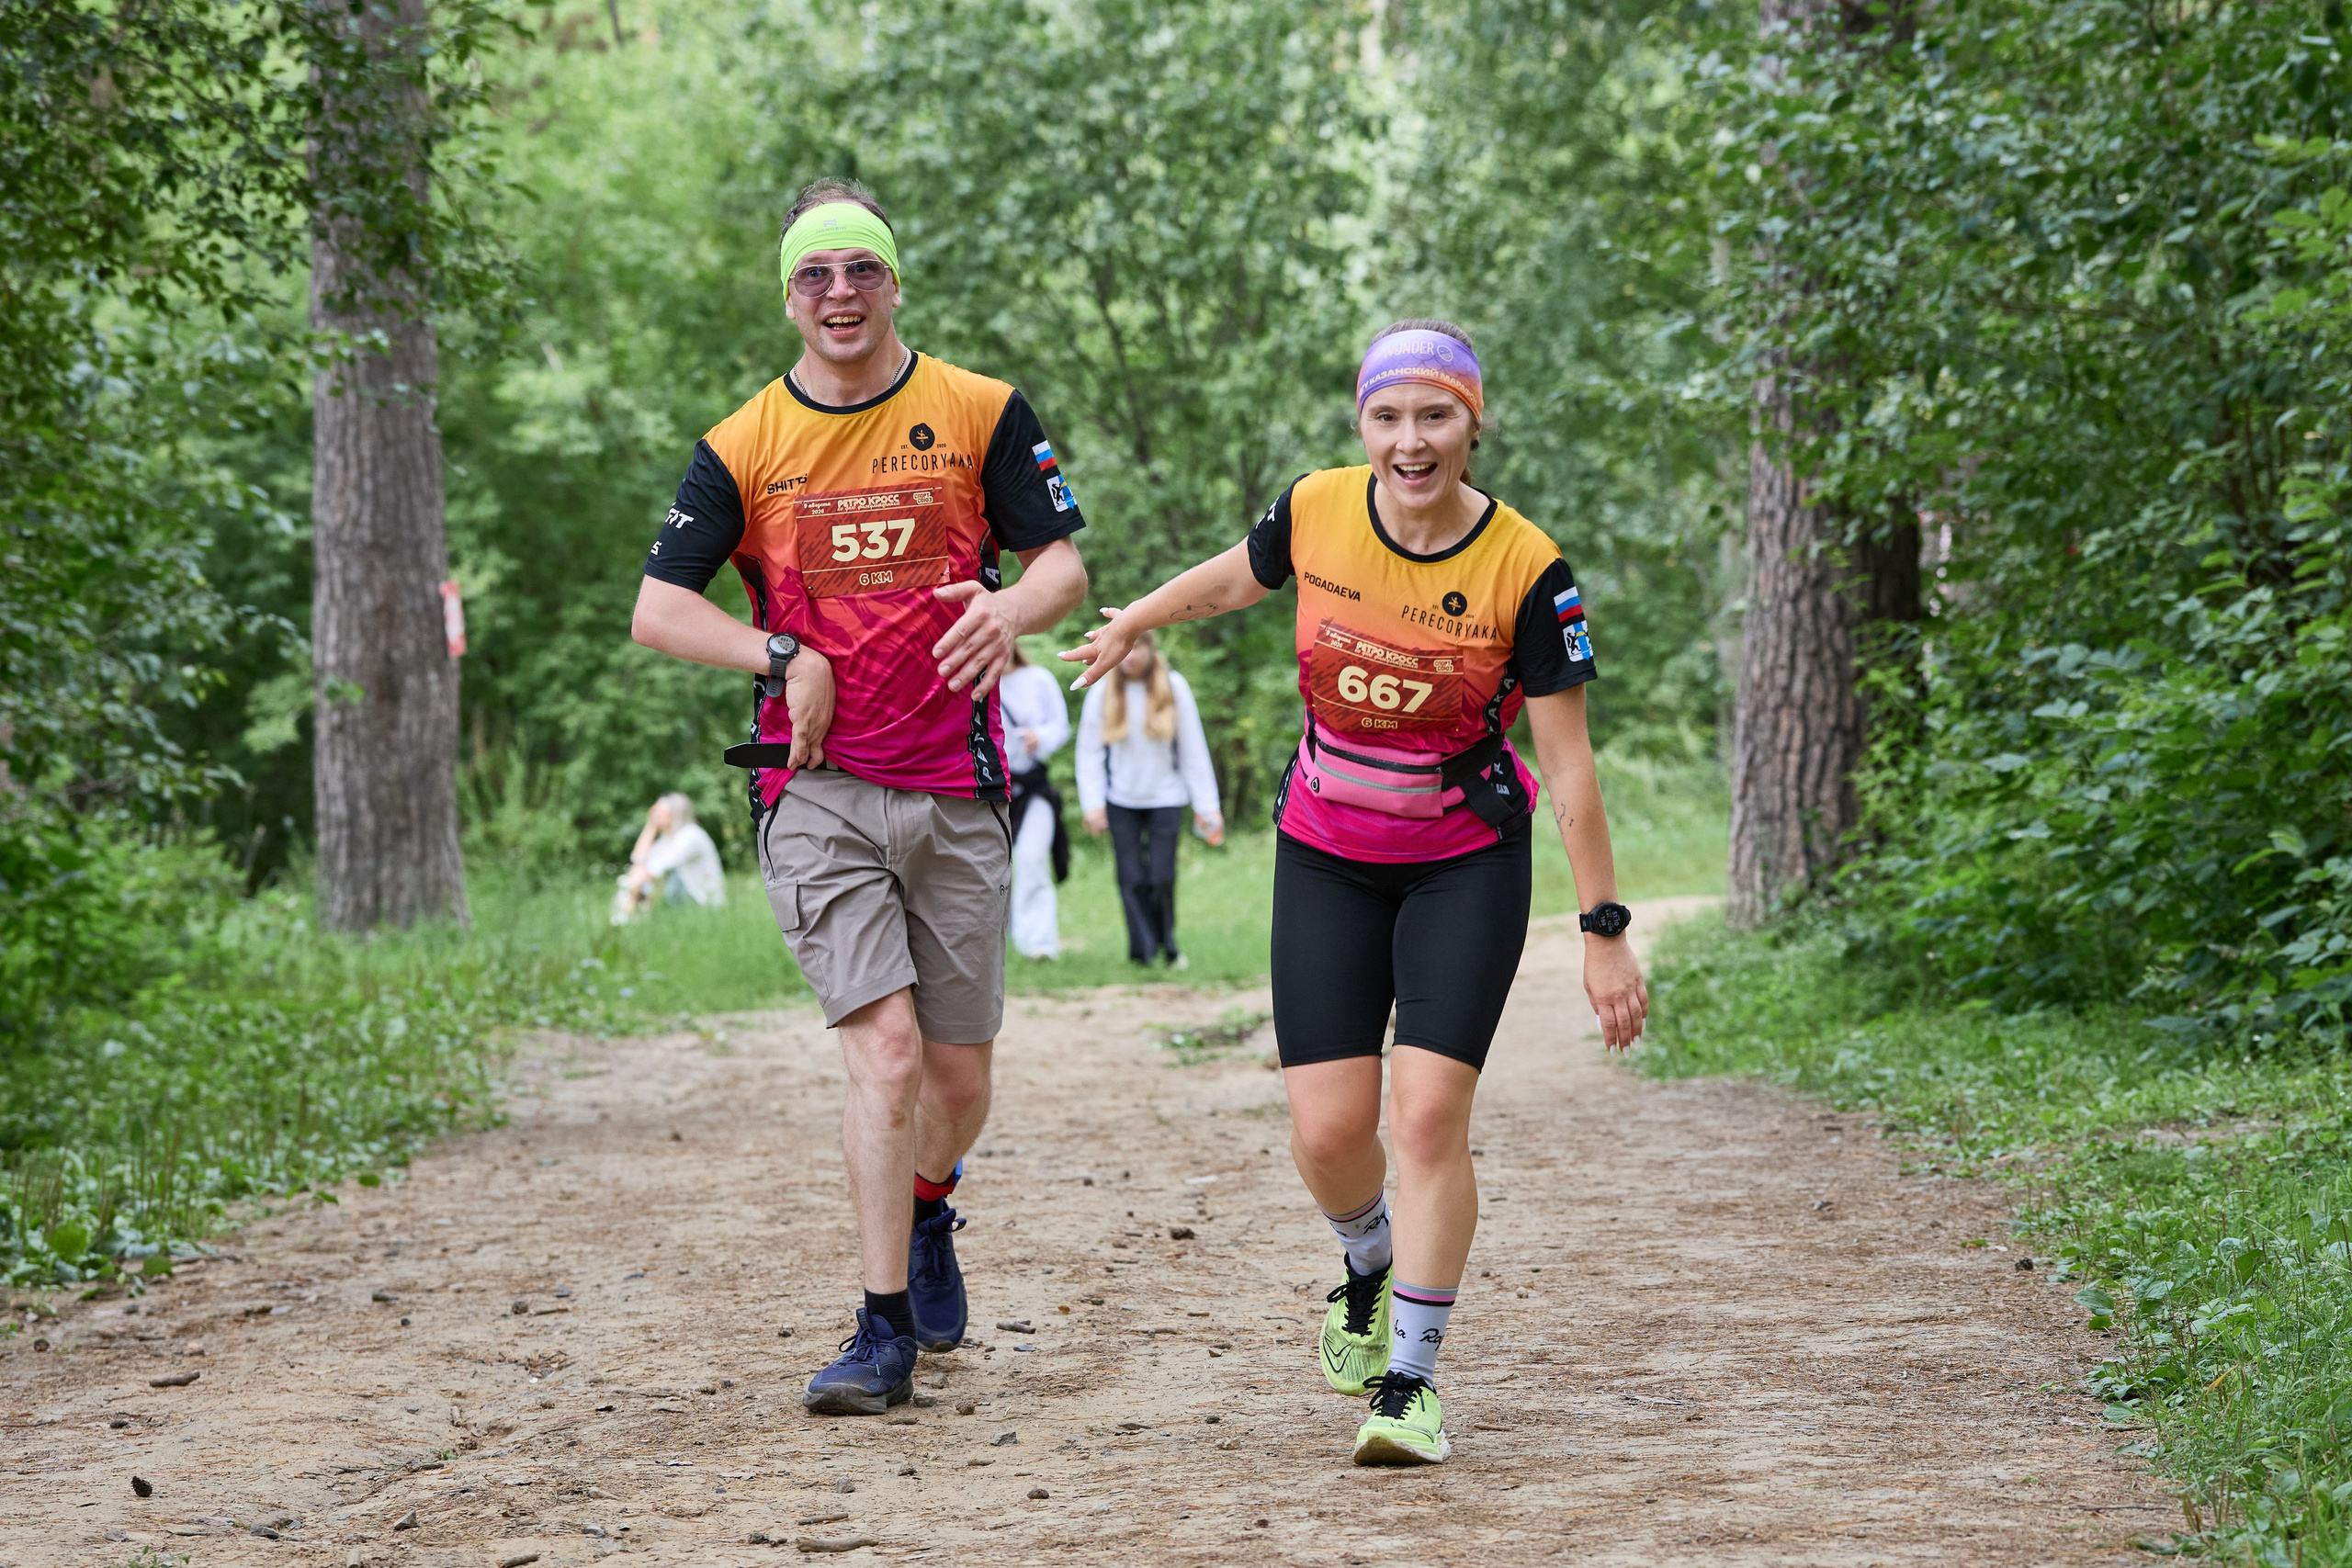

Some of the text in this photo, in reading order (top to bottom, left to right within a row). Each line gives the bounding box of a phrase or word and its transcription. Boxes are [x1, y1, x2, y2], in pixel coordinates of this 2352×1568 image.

[1369, 367, 1438, 385] КАЗАНСКИЙ
[1440, 372, 1478, 405] МАРАФОН
[872, 452, 975, 474] PERECORYAKA
[837, 494, 899, 509] РЕТРО КРОСС
[831, 518, 916, 562] 537
[859, 573, 869, 586] 6
[1304, 571, 1361, 603] POGADAEVA
[1401, 604, 1498, 640] PERECORYAKA
[1356, 641, 1419, 666] РЕТРО КРОСС
[1338, 665, 1433, 713] 667
[1361, 716, 1373, 728] 6
